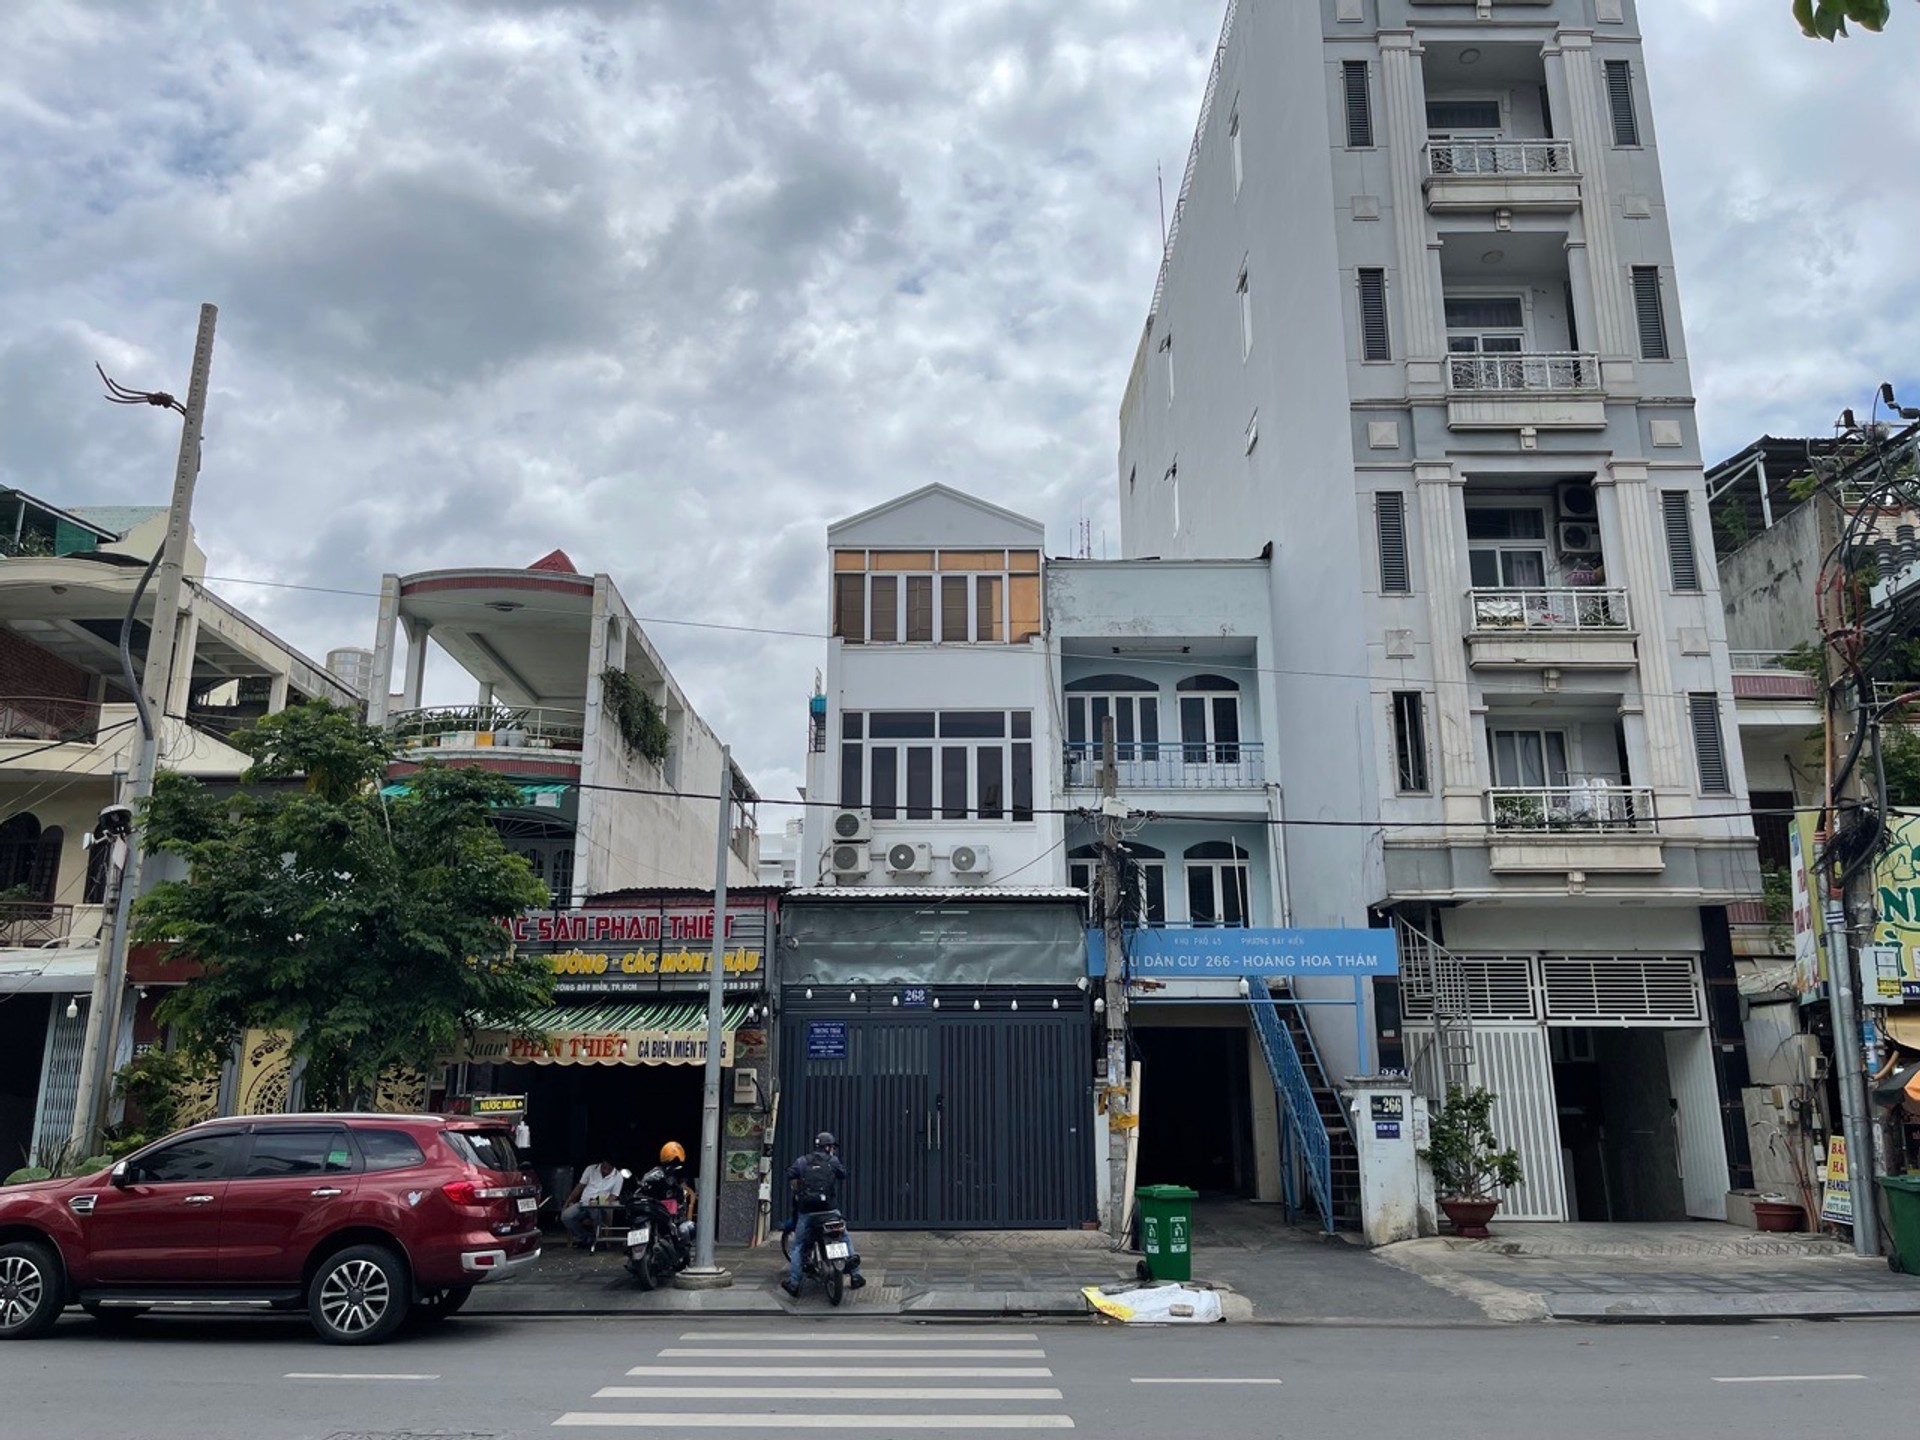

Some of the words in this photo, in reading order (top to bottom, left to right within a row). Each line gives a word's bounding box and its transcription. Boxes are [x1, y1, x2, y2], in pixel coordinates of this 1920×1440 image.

[1144, 953, 1174, 967] DÂN
[1206, 956, 1230, 967] 266
[1243, 952, 1296, 967] HOÀNG
[1301, 955, 1332, 967] HOA
[905, 989, 926, 1001] 268
[1382, 1097, 1402, 1112] 266
